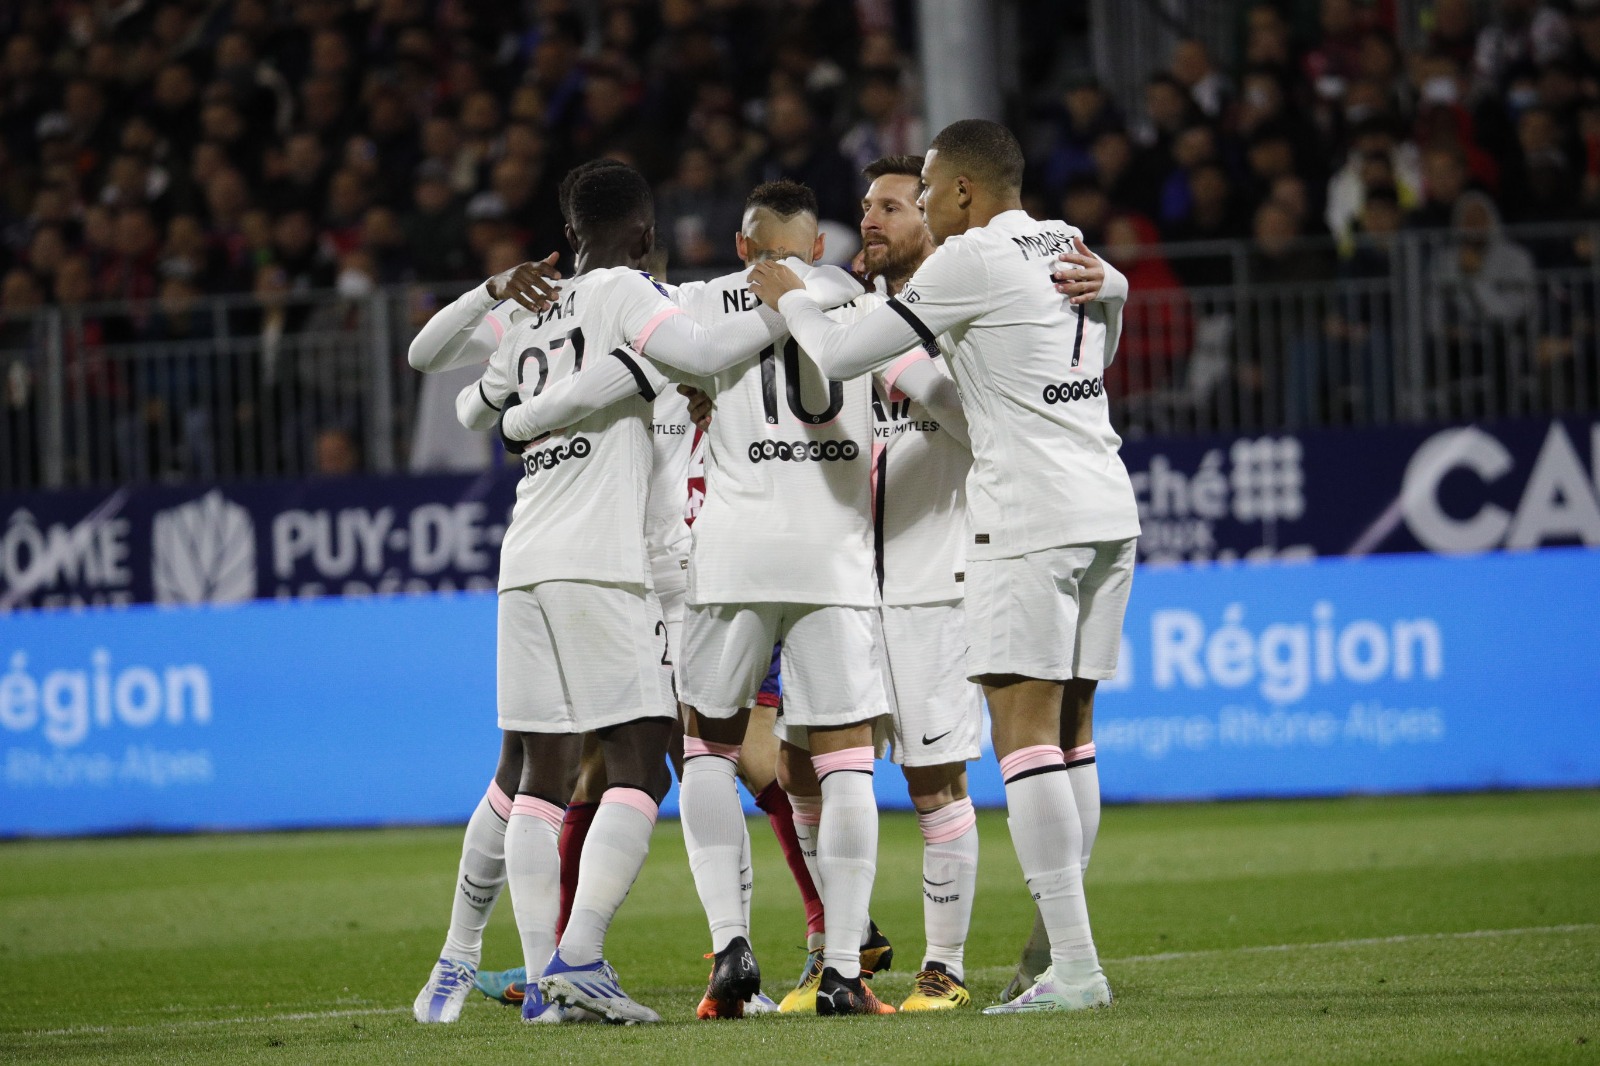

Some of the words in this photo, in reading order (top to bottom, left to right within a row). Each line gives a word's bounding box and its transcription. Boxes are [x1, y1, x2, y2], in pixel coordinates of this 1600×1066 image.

[758, 335, 844, 425] 10
[749, 438, 859, 463] ooredoo
[873, 427, 890, 438] VE
[1401, 418, 1600, 556] CA
[0, 507, 132, 587] ÔME
[1150, 601, 1443, 702] Région
[0, 649, 212, 746] égion
